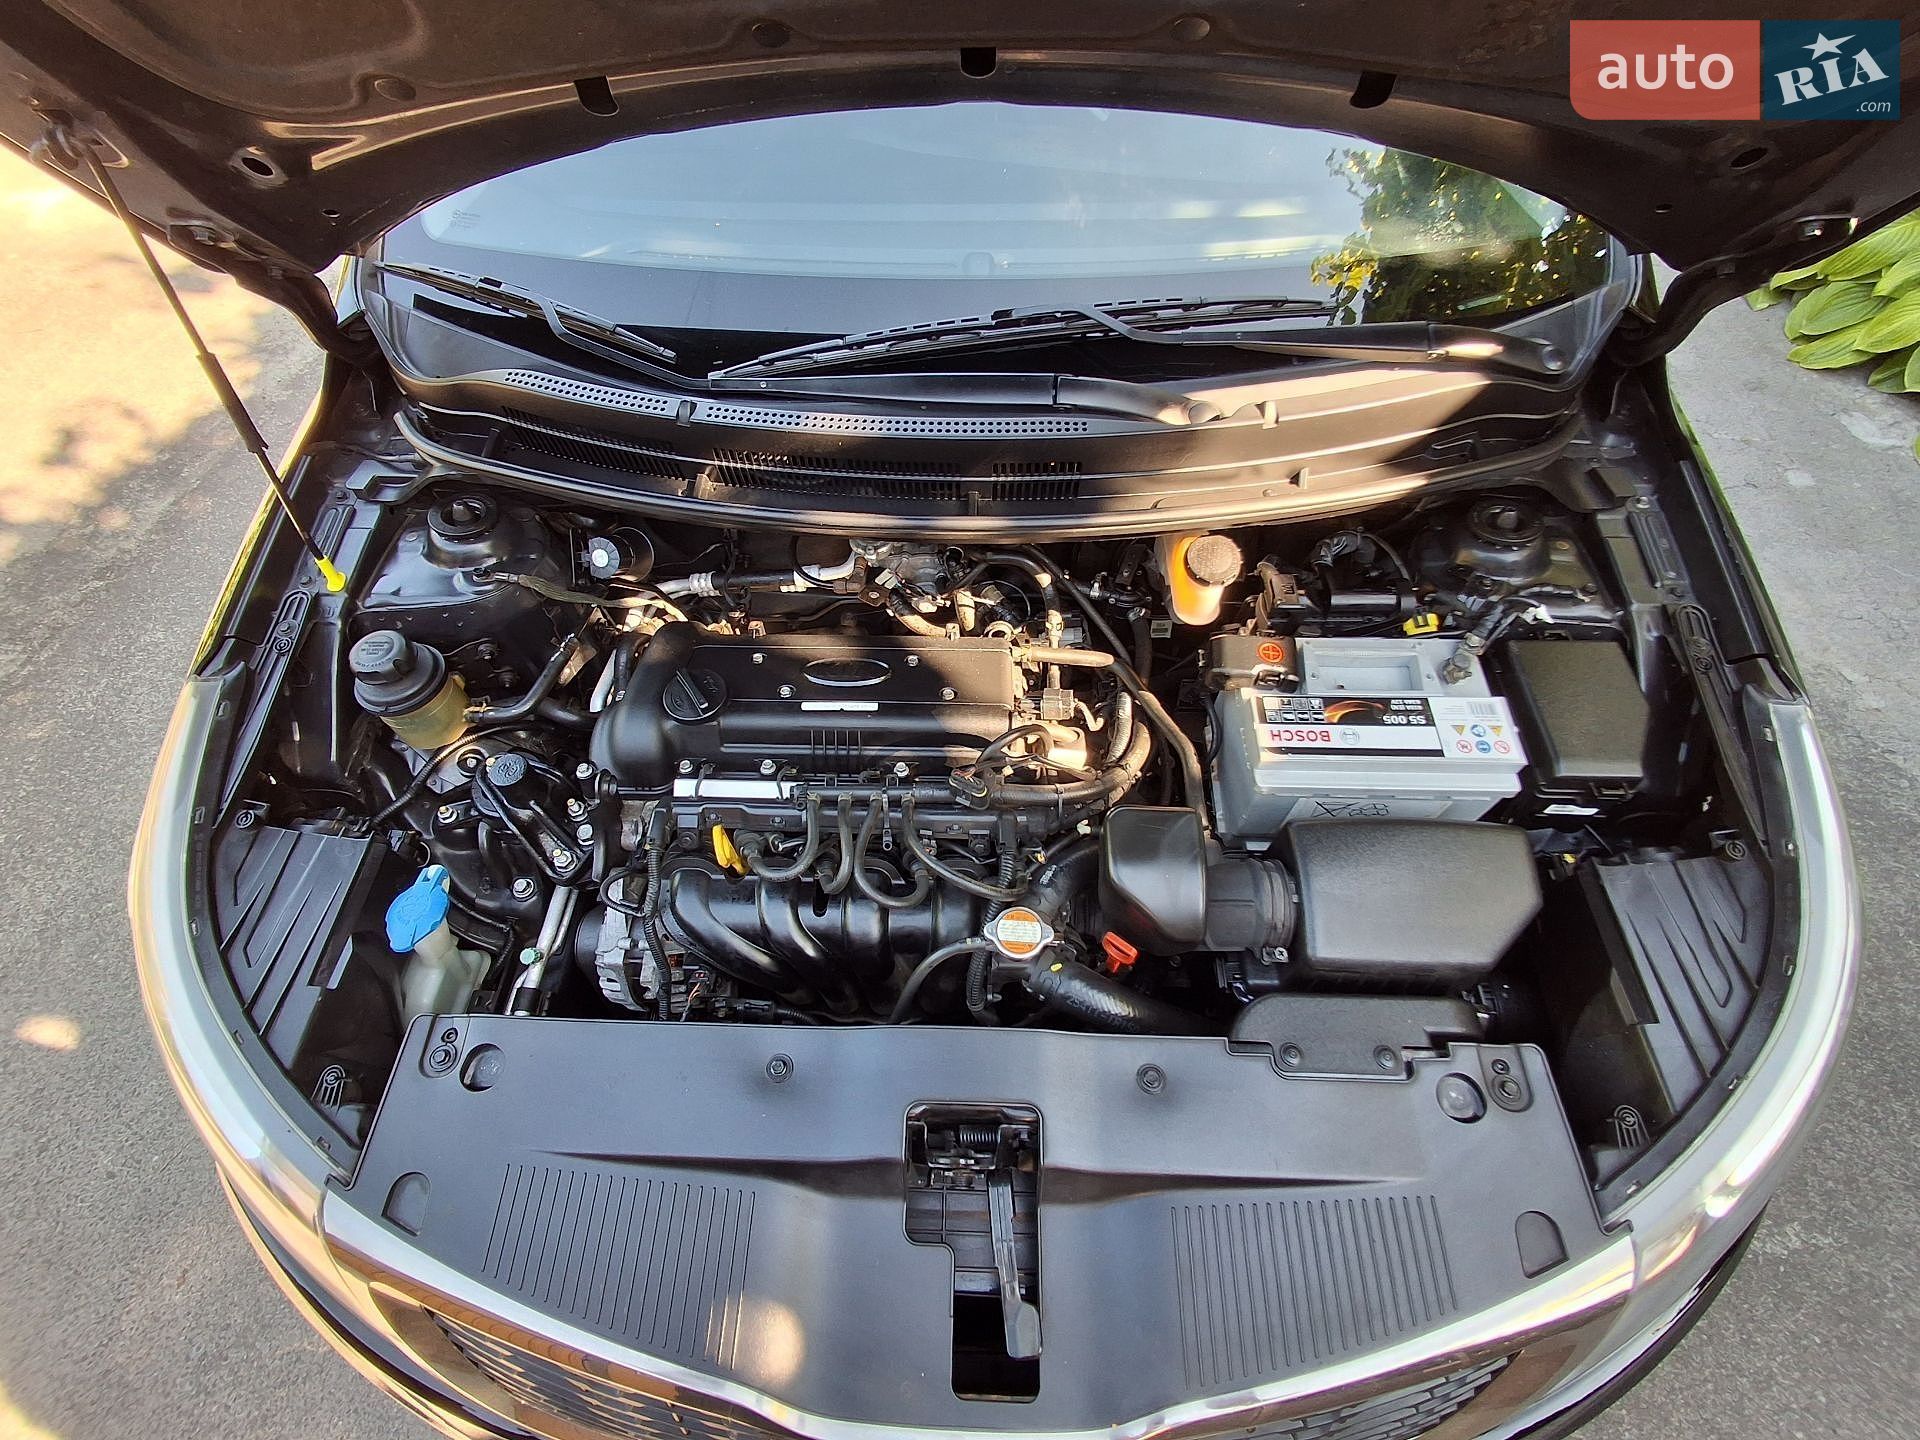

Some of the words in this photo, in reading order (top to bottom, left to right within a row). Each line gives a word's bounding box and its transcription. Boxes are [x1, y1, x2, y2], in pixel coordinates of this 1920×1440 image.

[1382, 715, 1407, 725] 005
[1408, 715, 1427, 725] S5
[1270, 730, 1332, 742] BOSCH
